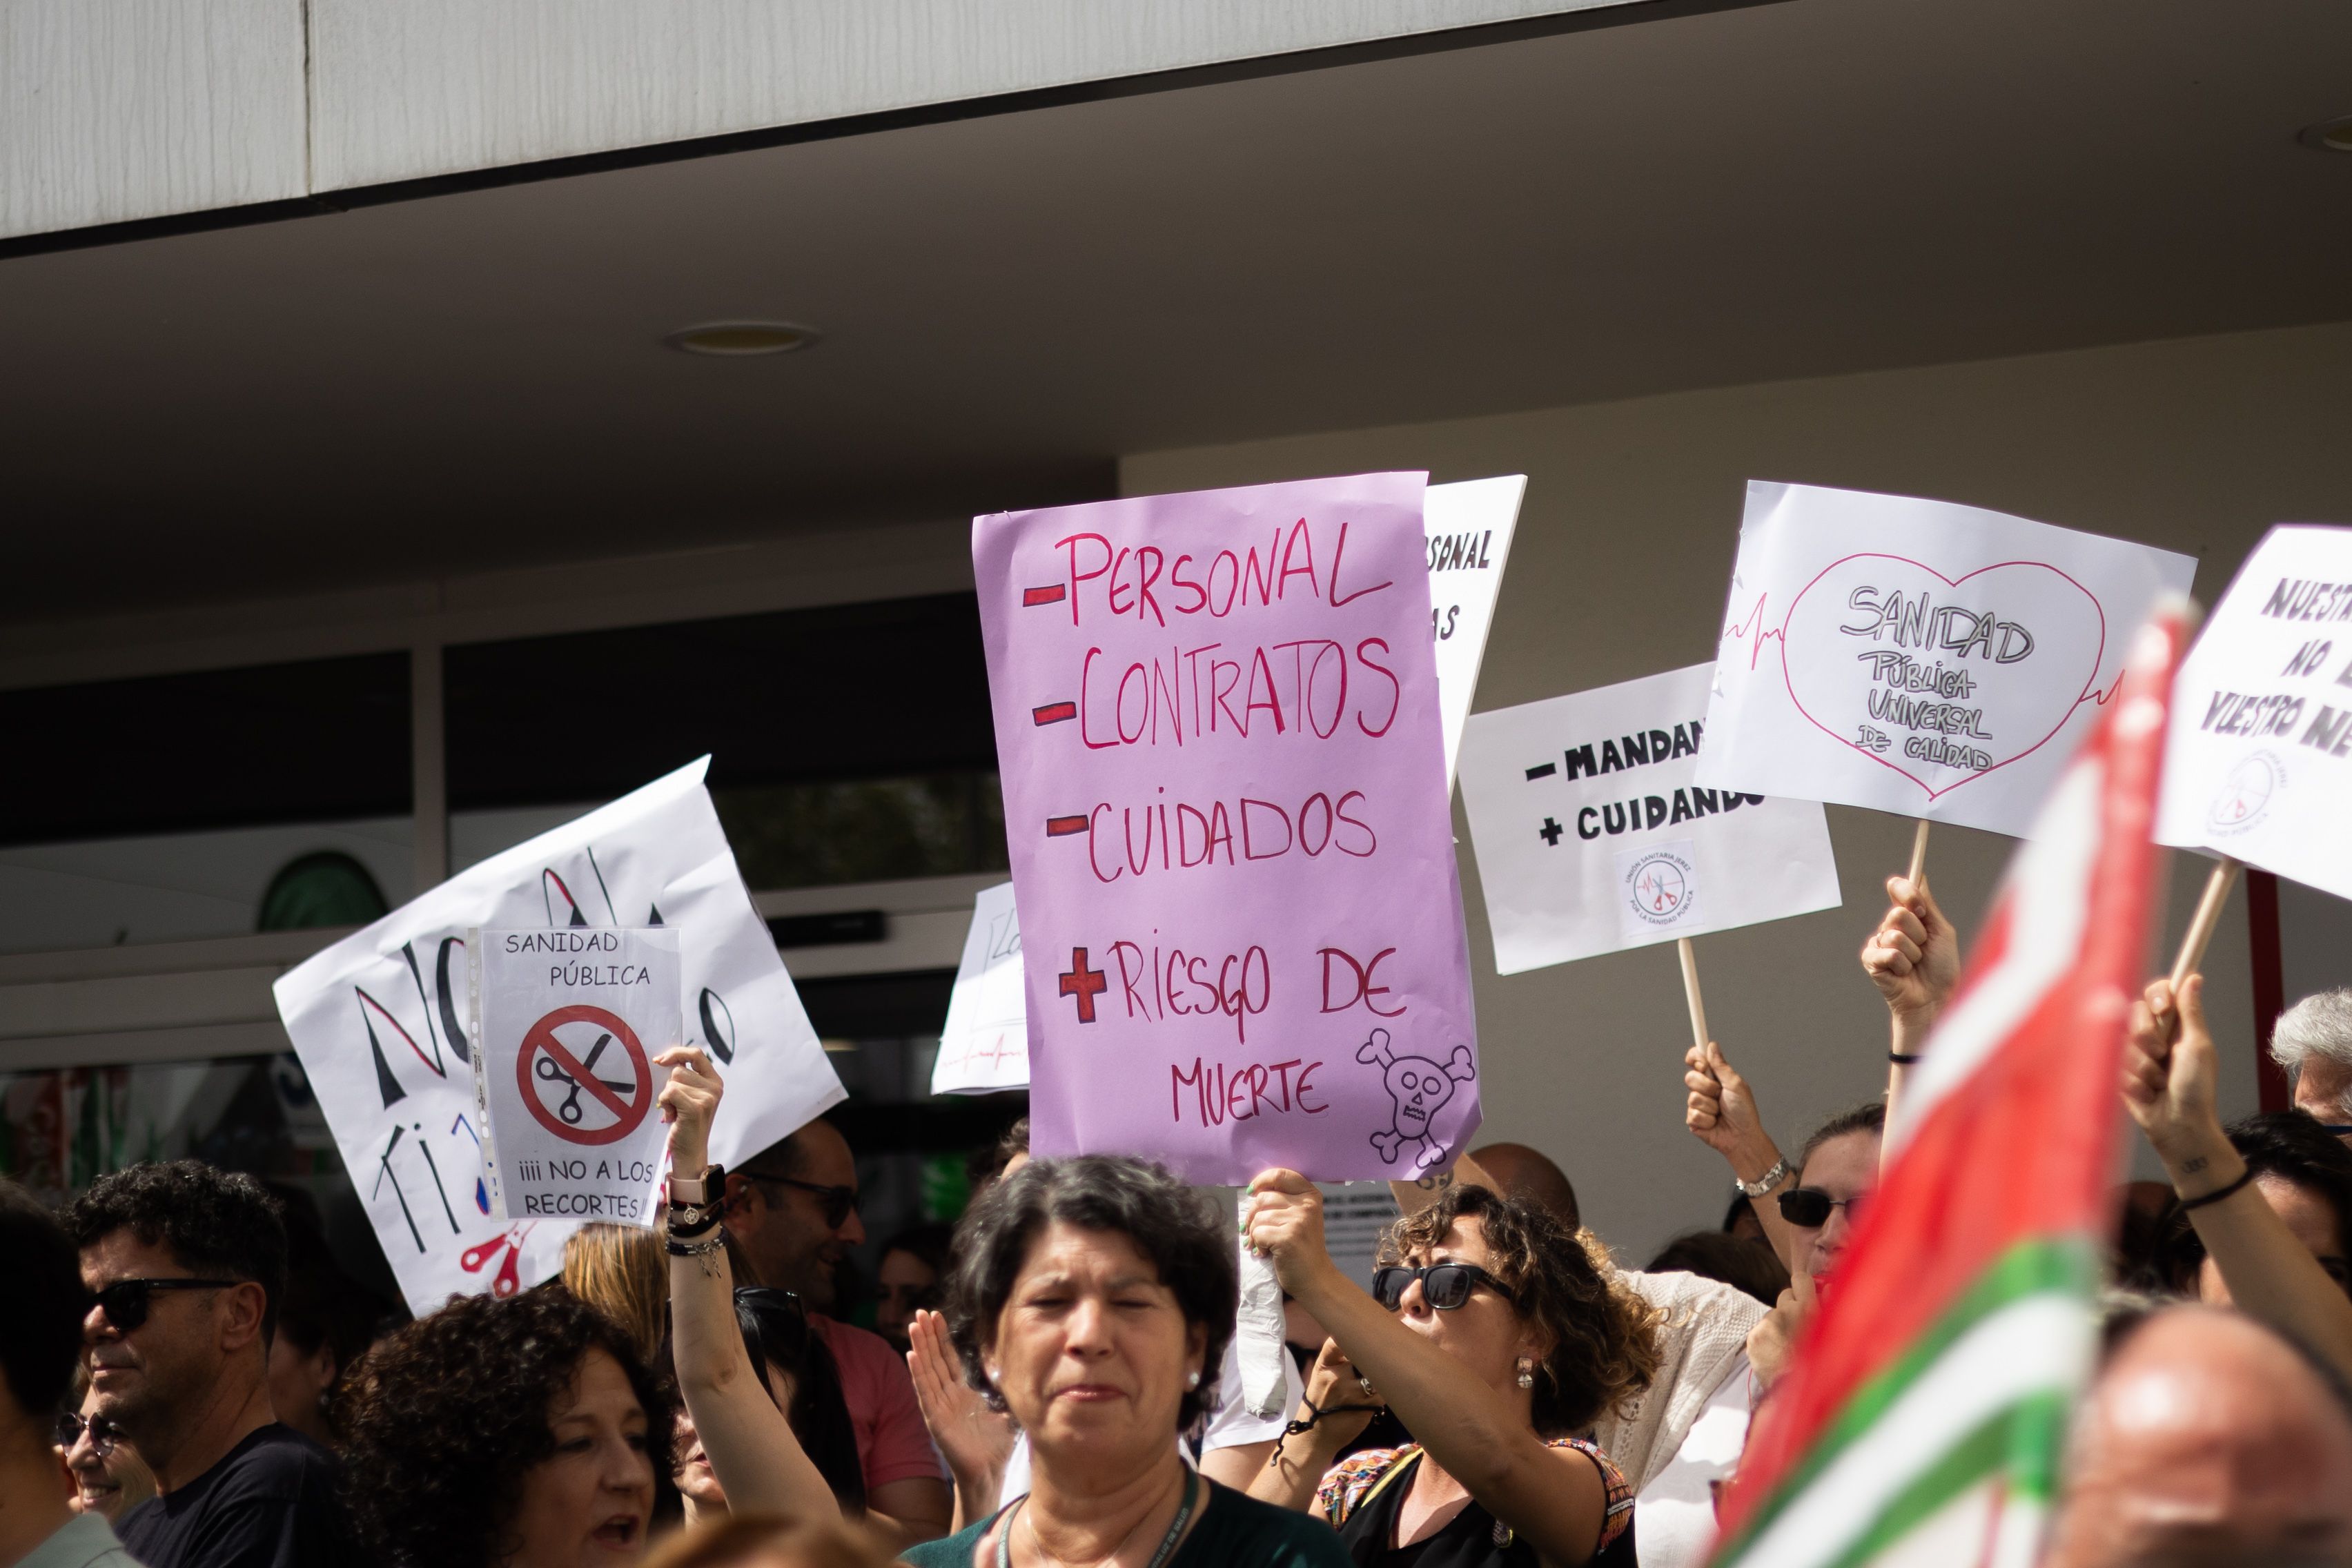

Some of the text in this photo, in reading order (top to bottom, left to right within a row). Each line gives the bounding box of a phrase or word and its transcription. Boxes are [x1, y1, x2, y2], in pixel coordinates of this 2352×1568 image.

[1055, 516, 1393, 627] PERSONAL
[1424, 530, 1492, 573] SONAL
[1839, 585, 2035, 664] SANIDAD
[2279, 639, 2333, 678] NO
[1081, 637, 1400, 750] CONTRATOS
[1868, 688, 1993, 741] UNIVERSAL
[2200, 691, 2307, 738] VUESTRO
[1855, 724, 1892, 753] DE
[1625, 852, 1692, 884] UNIÓN SANITARIA JEREZ
[1647, 915, 1678, 925] SANIDAD
[505, 932, 618, 953] SANIDAD
[550, 960, 651, 987] PÚBLICA
[1316, 947, 1407, 1017] DE
[1171, 1057, 1329, 1128] MUERTE
[549, 1159, 587, 1181] NO
[596, 1160, 611, 1181] A
[618, 1160, 654, 1184] LOS
